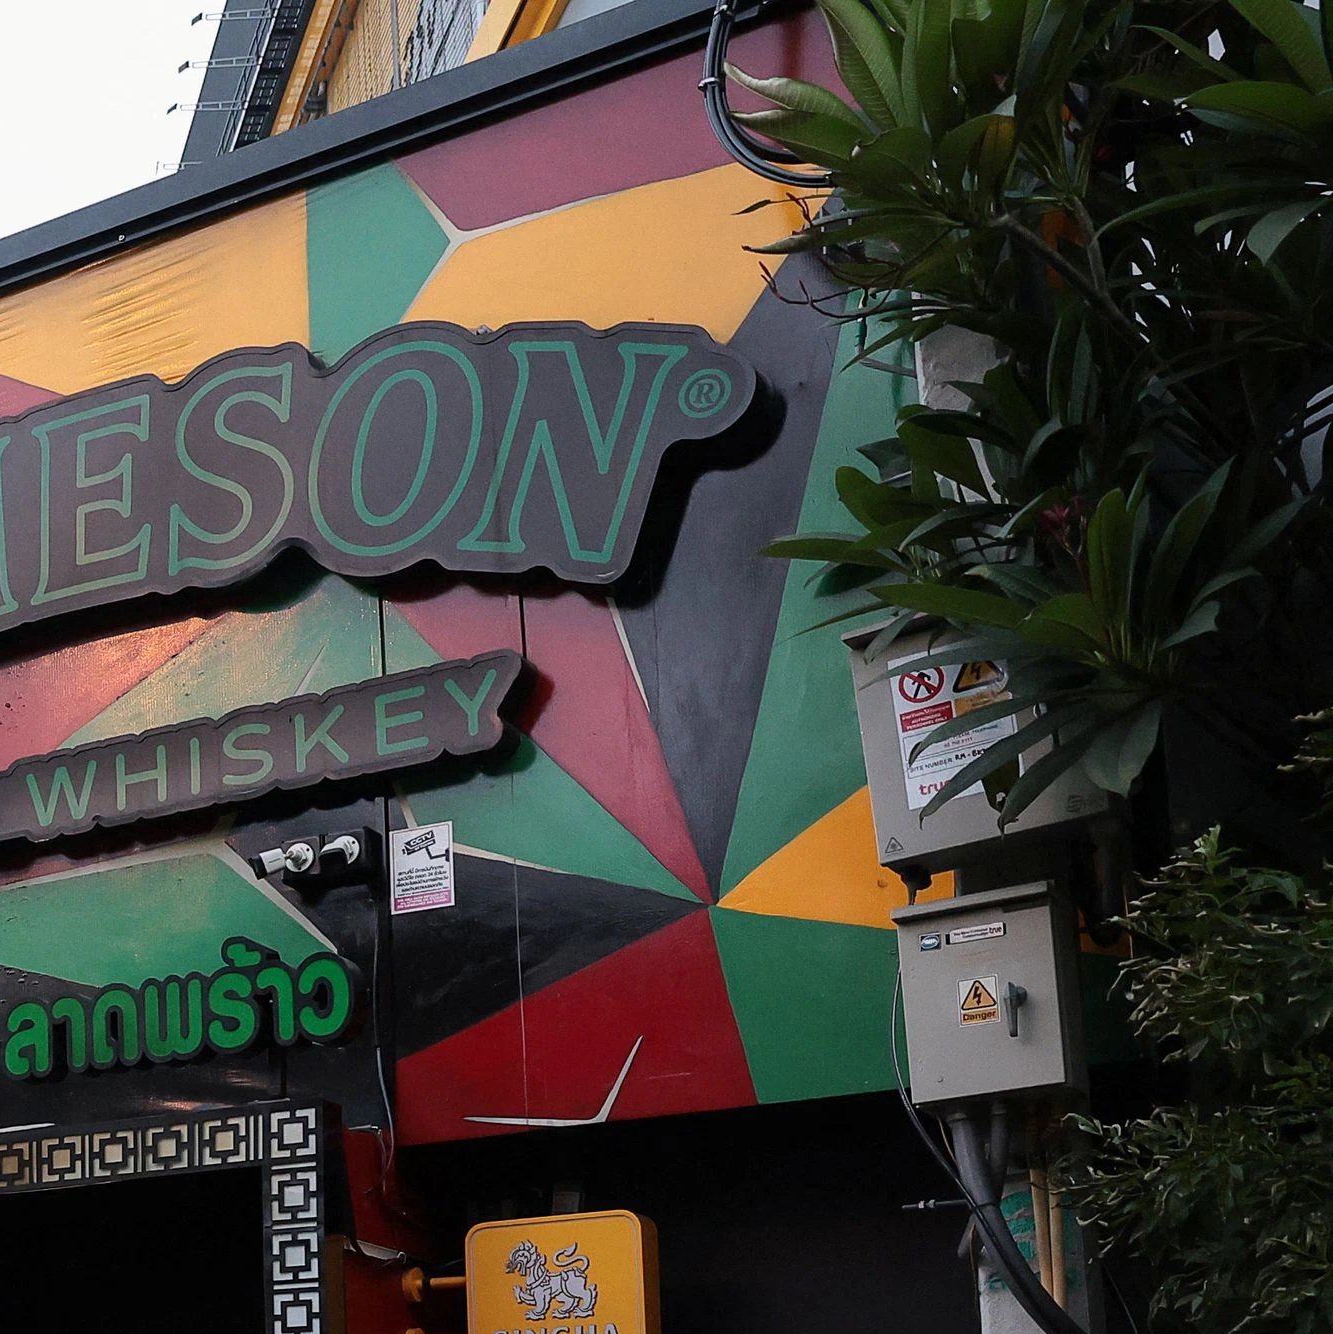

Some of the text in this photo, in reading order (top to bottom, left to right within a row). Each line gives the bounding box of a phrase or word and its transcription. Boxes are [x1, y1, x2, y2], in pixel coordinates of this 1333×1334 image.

[27, 667, 499, 827] WHISKEY
[918, 779, 950, 796] tru
[410, 832, 433, 846] CCTV
[989, 926, 1003, 935] true
[3, 941, 351, 1077] ลาดพร้าว
[962, 1010, 997, 1021] Danger
